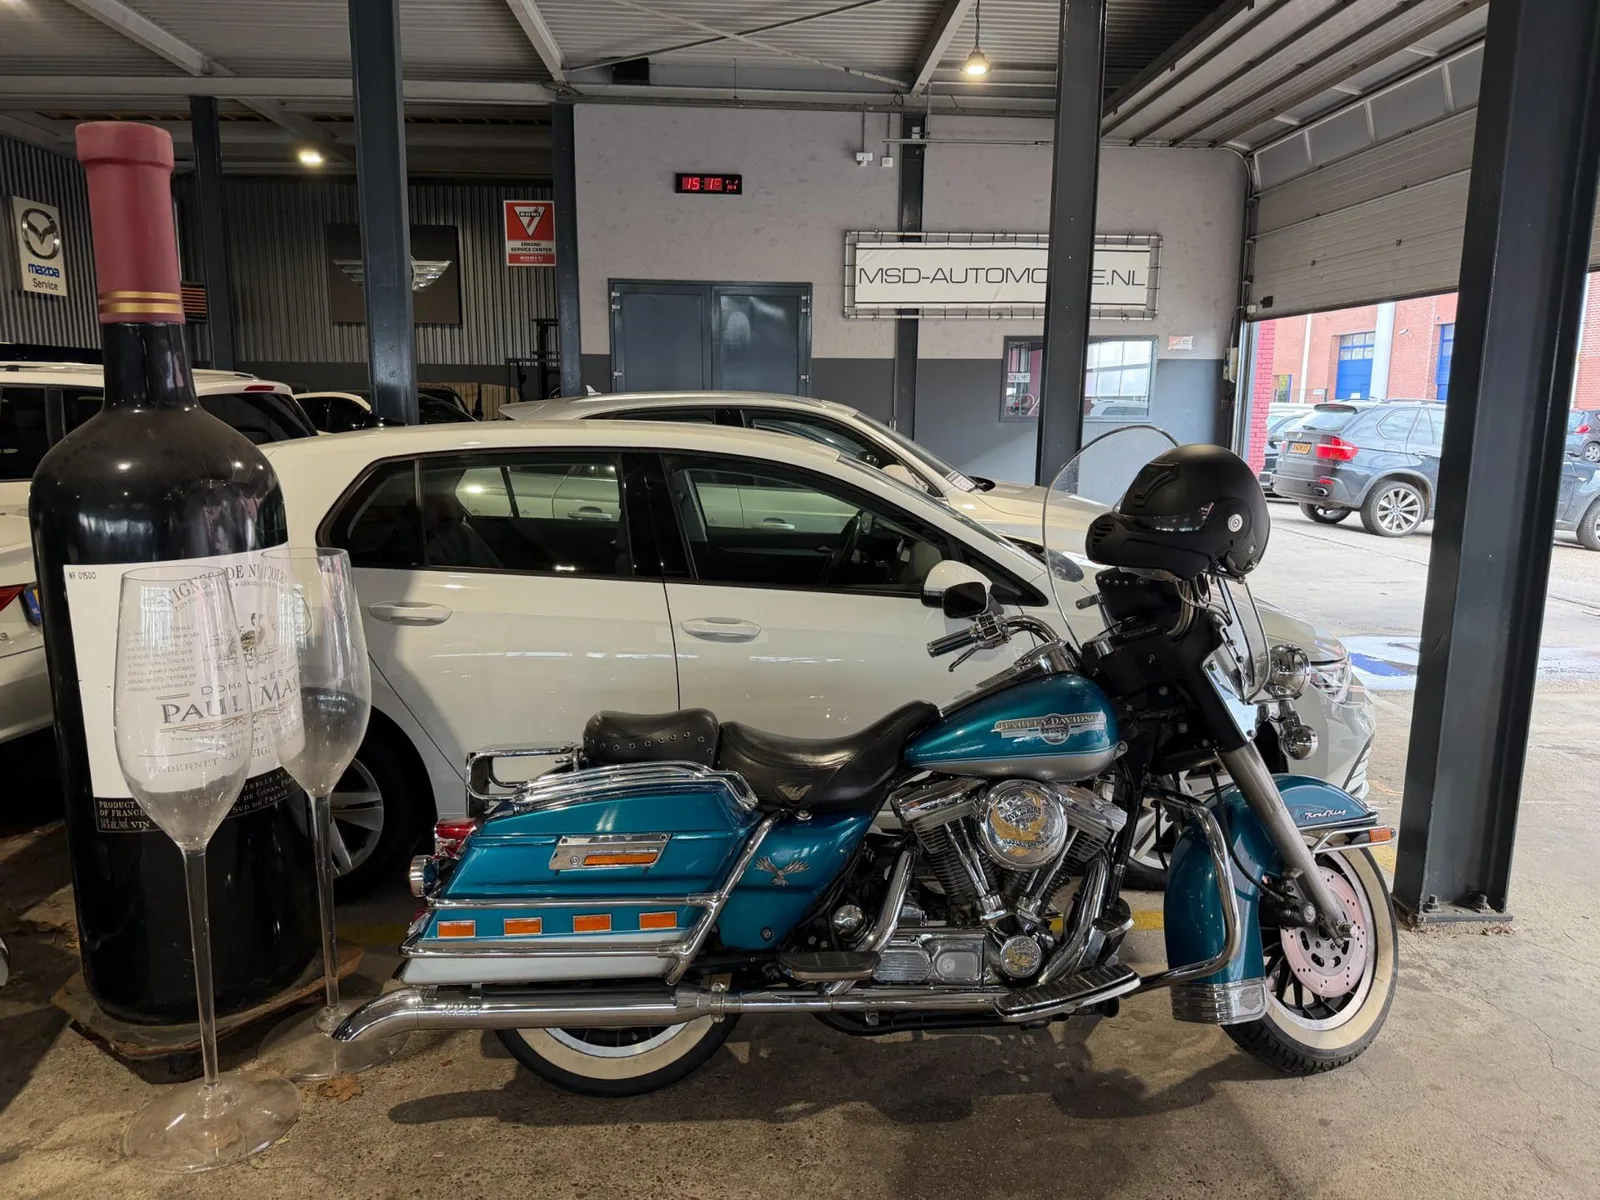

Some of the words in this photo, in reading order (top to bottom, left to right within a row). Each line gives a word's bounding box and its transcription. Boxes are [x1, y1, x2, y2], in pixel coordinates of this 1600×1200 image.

[859, 267, 1146, 286] MSD-AUTOMOE.NL
[33, 278, 58, 290] Service
[78, 571, 97, 579] 01500
[225, 564, 245, 580] DE
[161, 695, 243, 724] PAUL
[99, 801, 135, 809] PRODUCT
[232, 804, 250, 813] SUD
[265, 790, 288, 804] FRANCE
[112, 809, 146, 817] FRANCE
[131, 821, 150, 829] VIN
